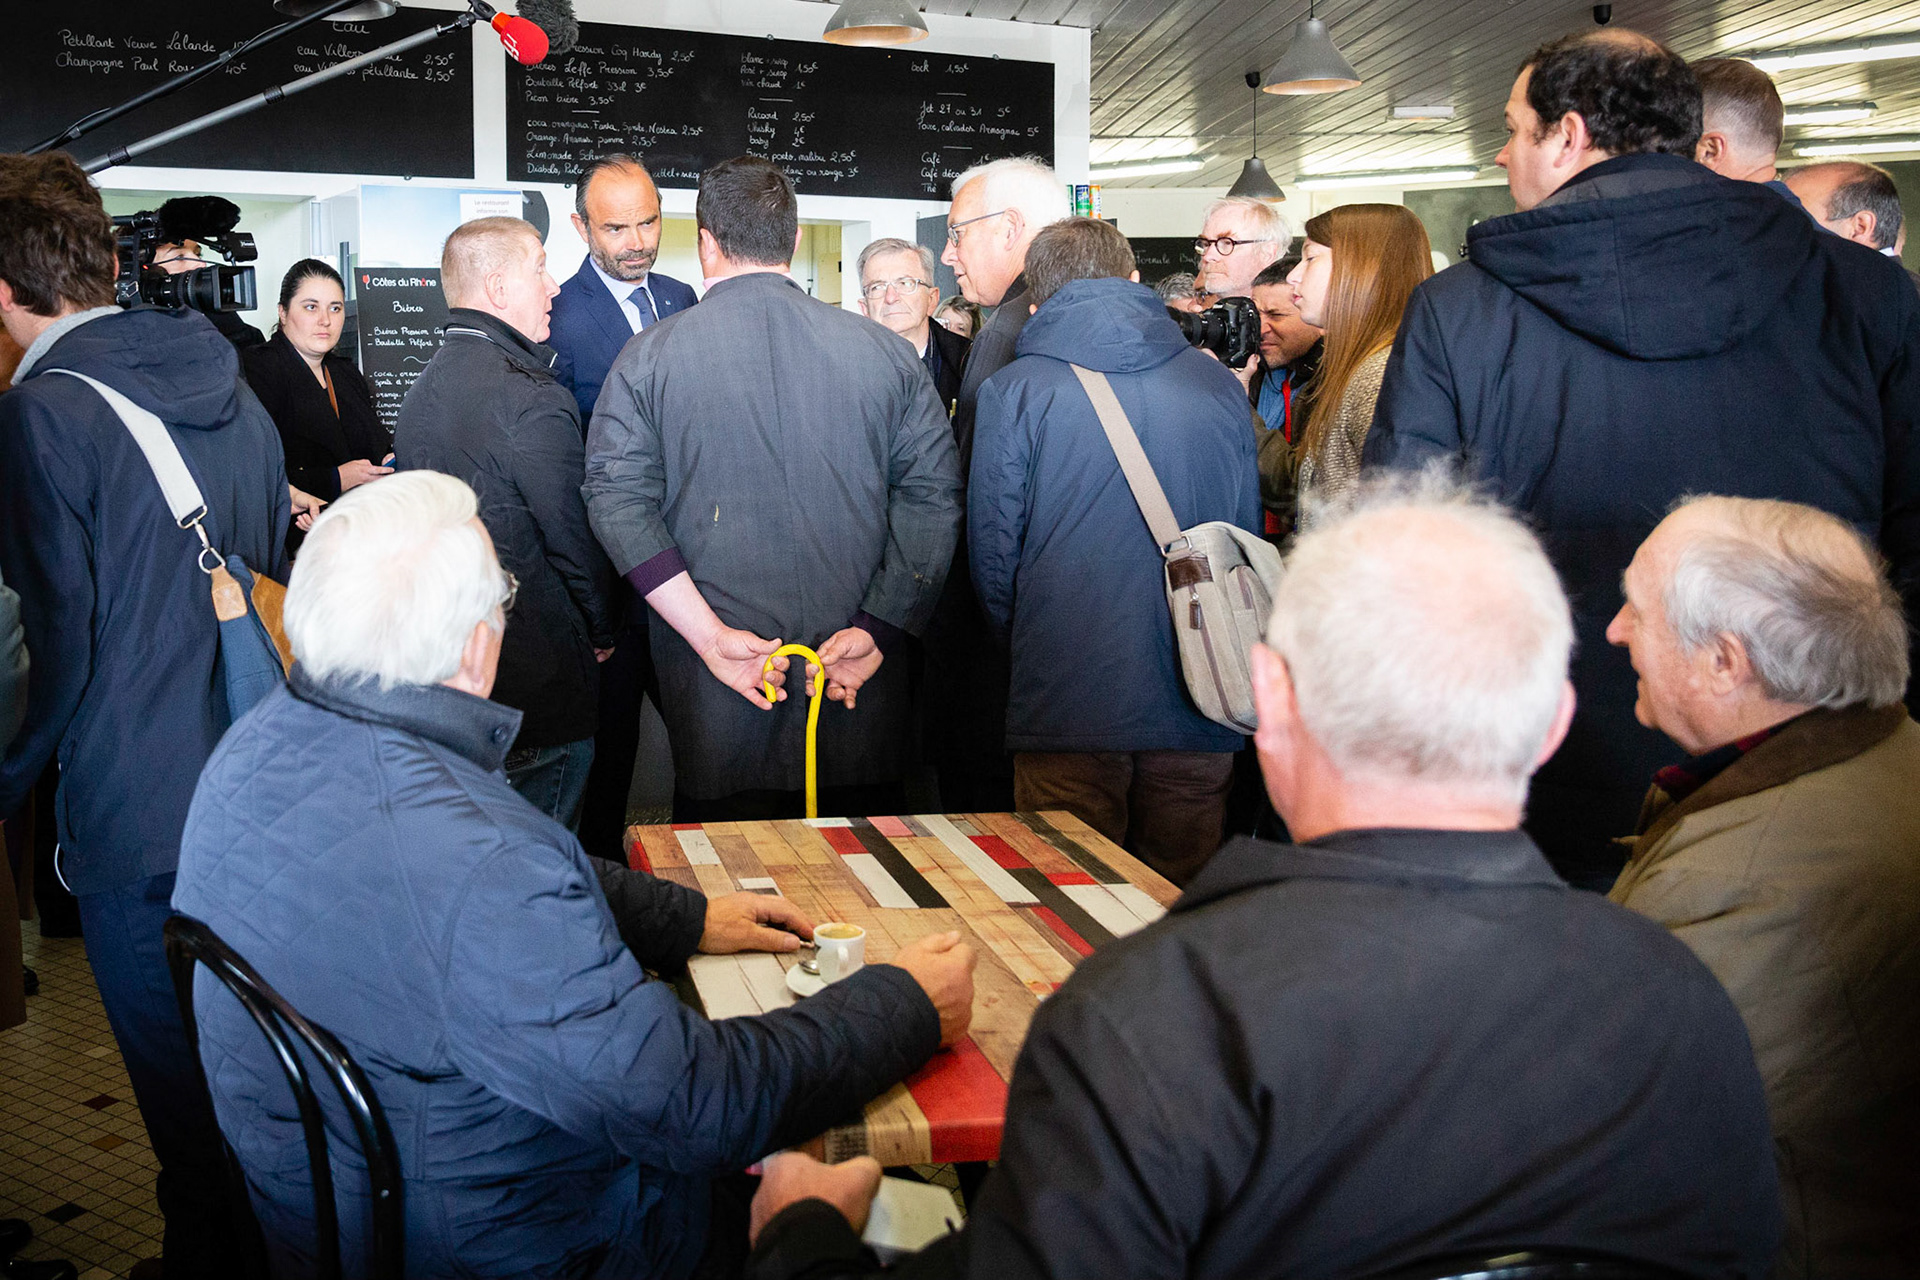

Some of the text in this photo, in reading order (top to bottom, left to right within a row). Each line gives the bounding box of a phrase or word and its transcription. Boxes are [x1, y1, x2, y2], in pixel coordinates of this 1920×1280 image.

[58, 29, 115, 48] Pétillant
[123, 36, 157, 48] Veuve
[166, 31, 216, 52] Lalande
[296, 45, 319, 56] eau
[573, 44, 605, 55] ression
[611, 44, 628, 60] Coq
[632, 47, 662, 65] Hardy
[56, 51, 124, 74] Champagne
[131, 56, 158, 71] Paul
[169, 60, 194, 72] Rou
[564, 57, 592, 78] Leffe
[599, 61, 638, 74] Pression
[911, 60, 930, 72] bock
[293, 63, 313, 73] eau
[362, 63, 418, 81] pétillante
[757, 77, 782, 88] chaud
[525, 90, 549, 103] Picon
[556, 93, 579, 104] bière
[748, 107, 778, 120] Ricard
[939, 103, 951, 114] 27
[955, 108, 966, 116] ou
[970, 105, 982, 117] 31
[979, 122, 1020, 140] Armagnac
[598, 136, 625, 148] pomme
[749, 135, 769, 149] baby
[799, 150, 826, 162] malibu
[921, 151, 941, 167] Café
[820, 169, 845, 182] rouge
[920, 166, 938, 182] Café
[921, 181, 937, 193] Thé
[372, 277, 437, 287] Côtes du Rhône
[392, 300, 424, 312] Bières
